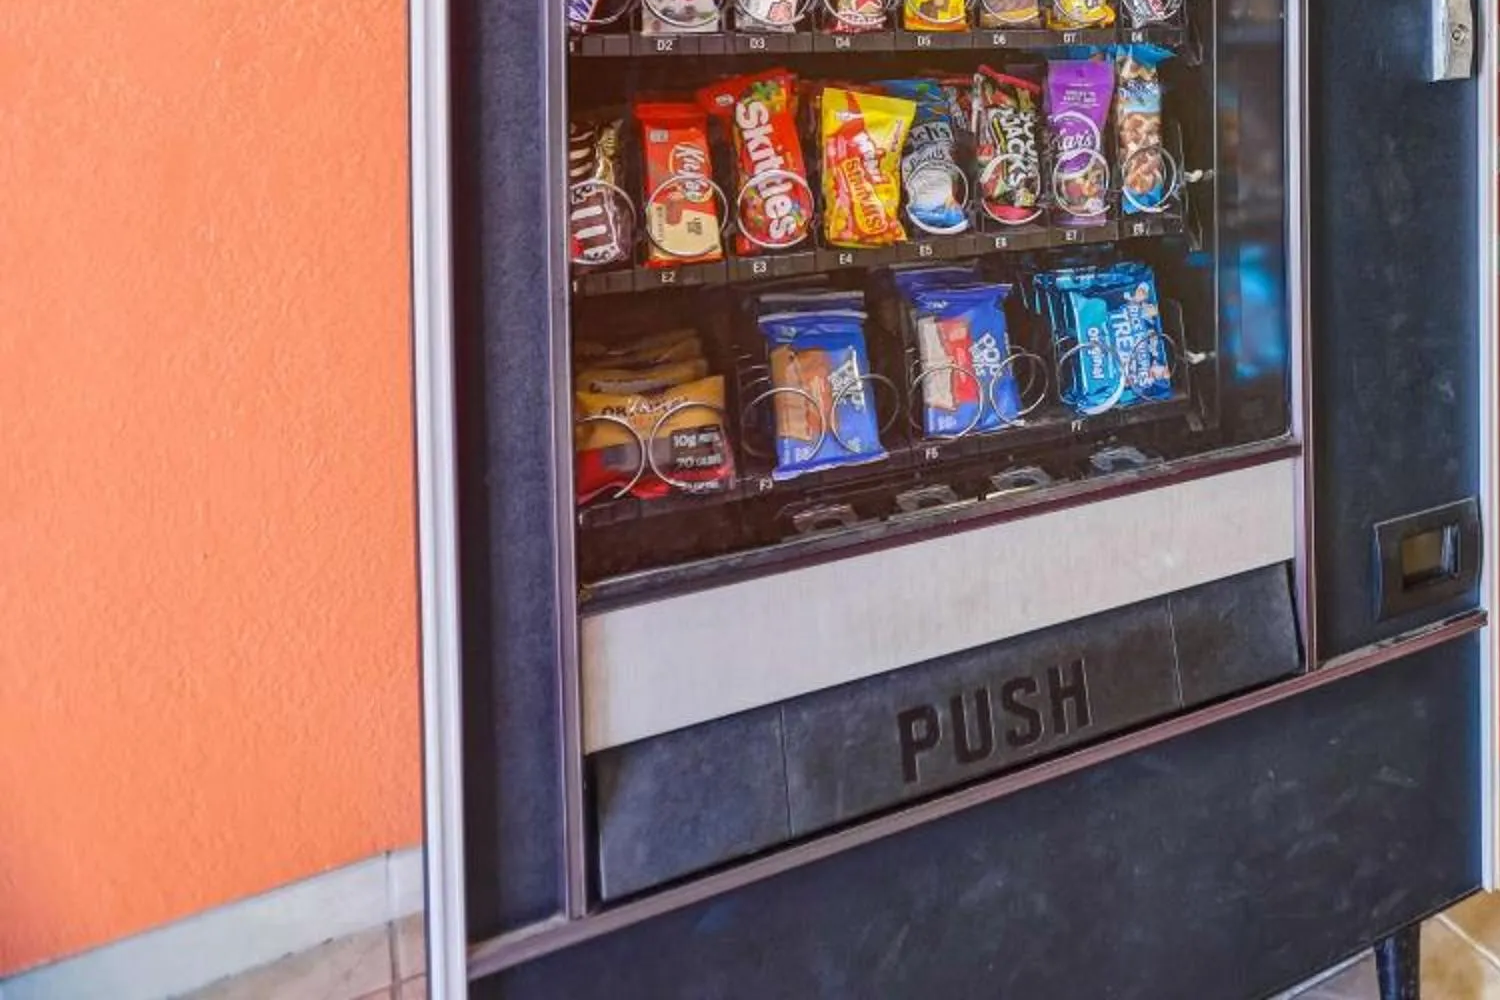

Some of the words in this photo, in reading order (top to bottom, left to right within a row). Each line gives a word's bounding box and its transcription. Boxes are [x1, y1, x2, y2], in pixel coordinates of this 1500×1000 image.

[656, 39, 673, 51] D2
[750, 38, 765, 49] D3
[835, 37, 850, 48] D4
[840, 253, 853, 265] E4
[753, 262, 767, 273] E3
[661, 272, 675, 283] E2
[897, 656, 1094, 784] PUSH
